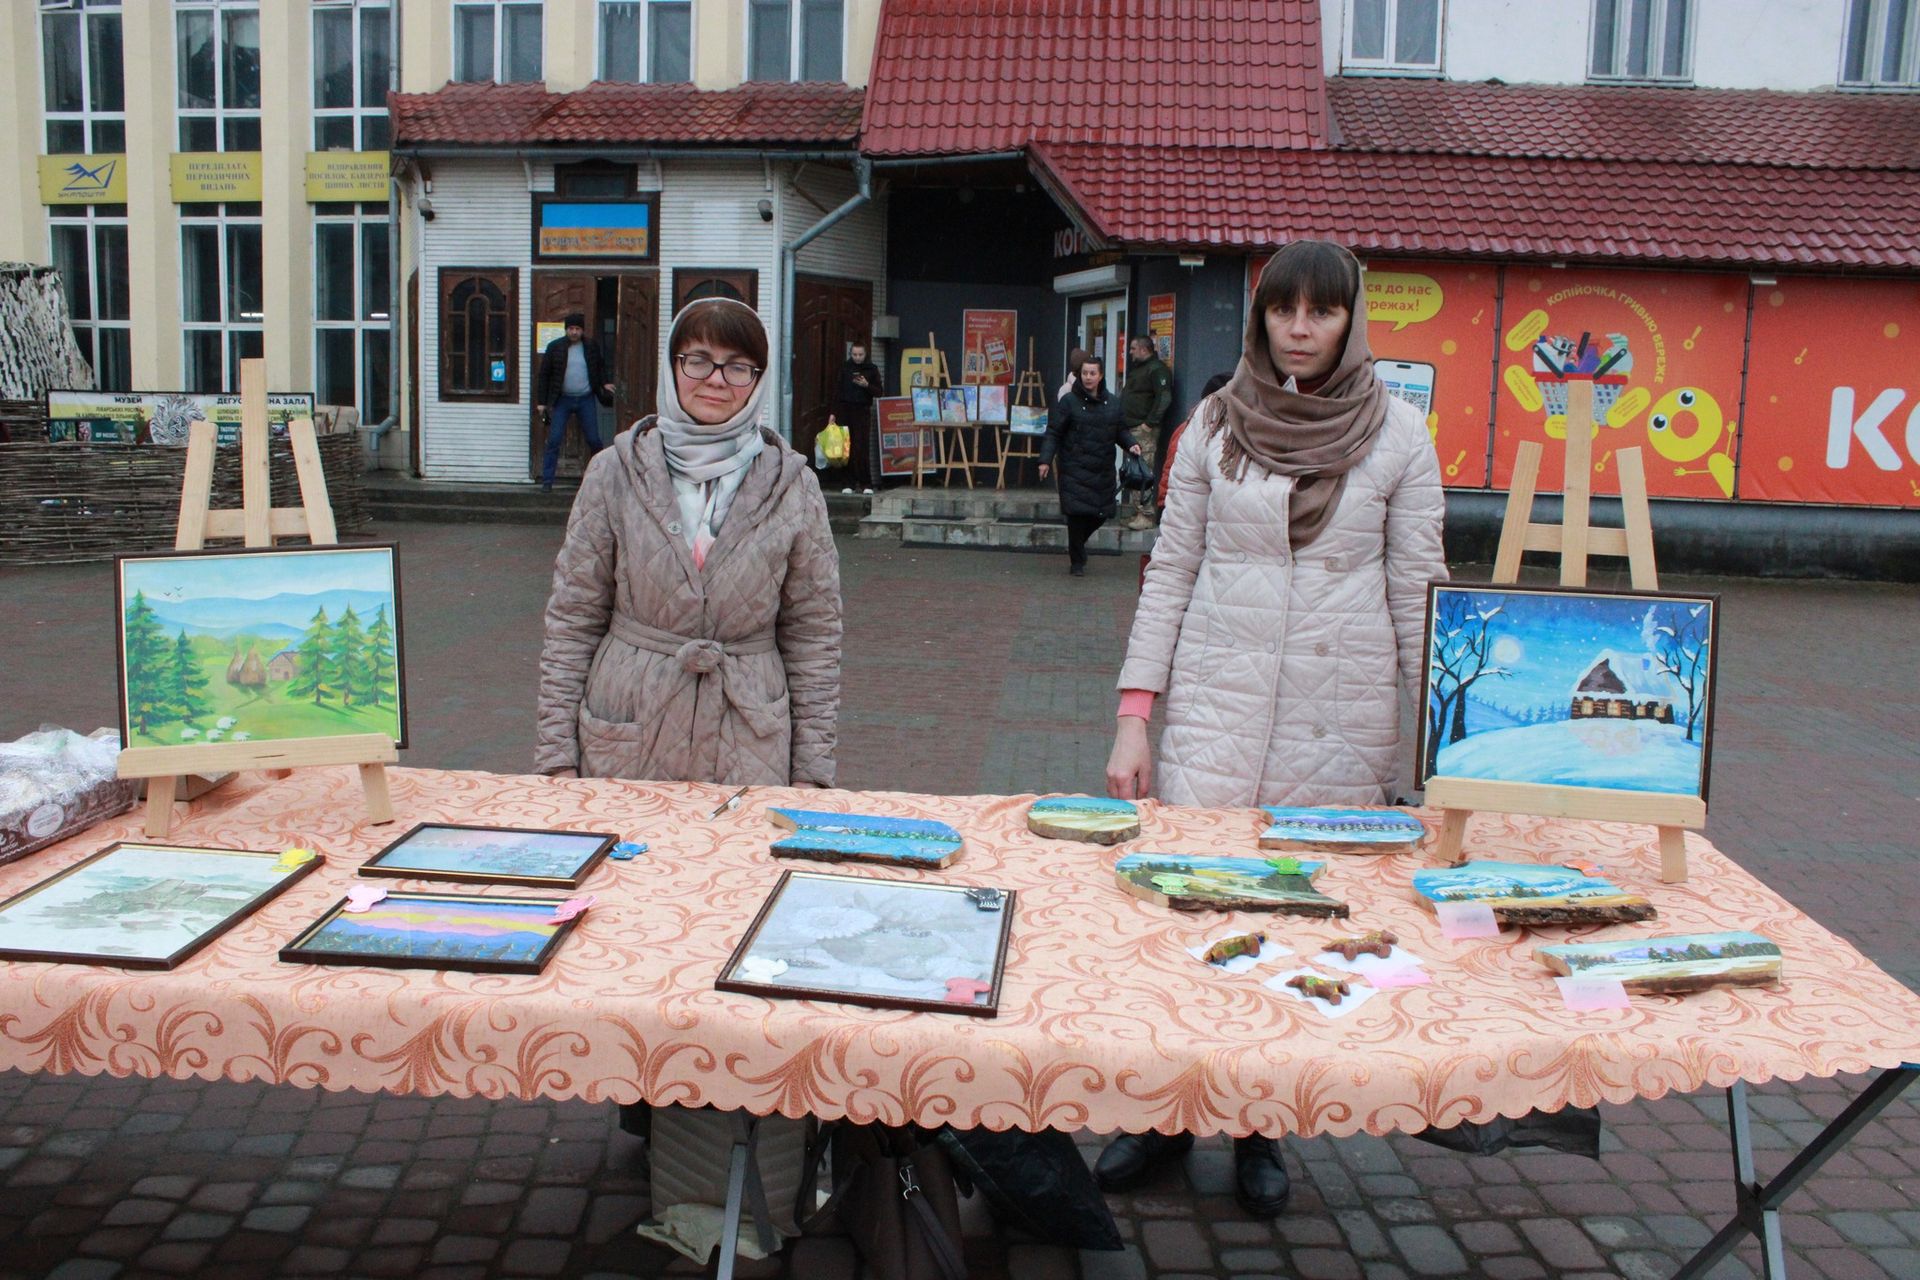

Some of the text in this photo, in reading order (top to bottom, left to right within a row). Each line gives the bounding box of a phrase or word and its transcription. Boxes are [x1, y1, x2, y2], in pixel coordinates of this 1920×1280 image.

[1365, 282, 1433, 296] ся до нас
[1546, 283, 1668, 385] КОПІЙОЧКА ГРИВНЮ БЕРЕЖЕ
[114, 395, 143, 404] МУЗЕЙ
[283, 398, 307, 406] ЗАЛА
[1826, 385, 1920, 472] К
